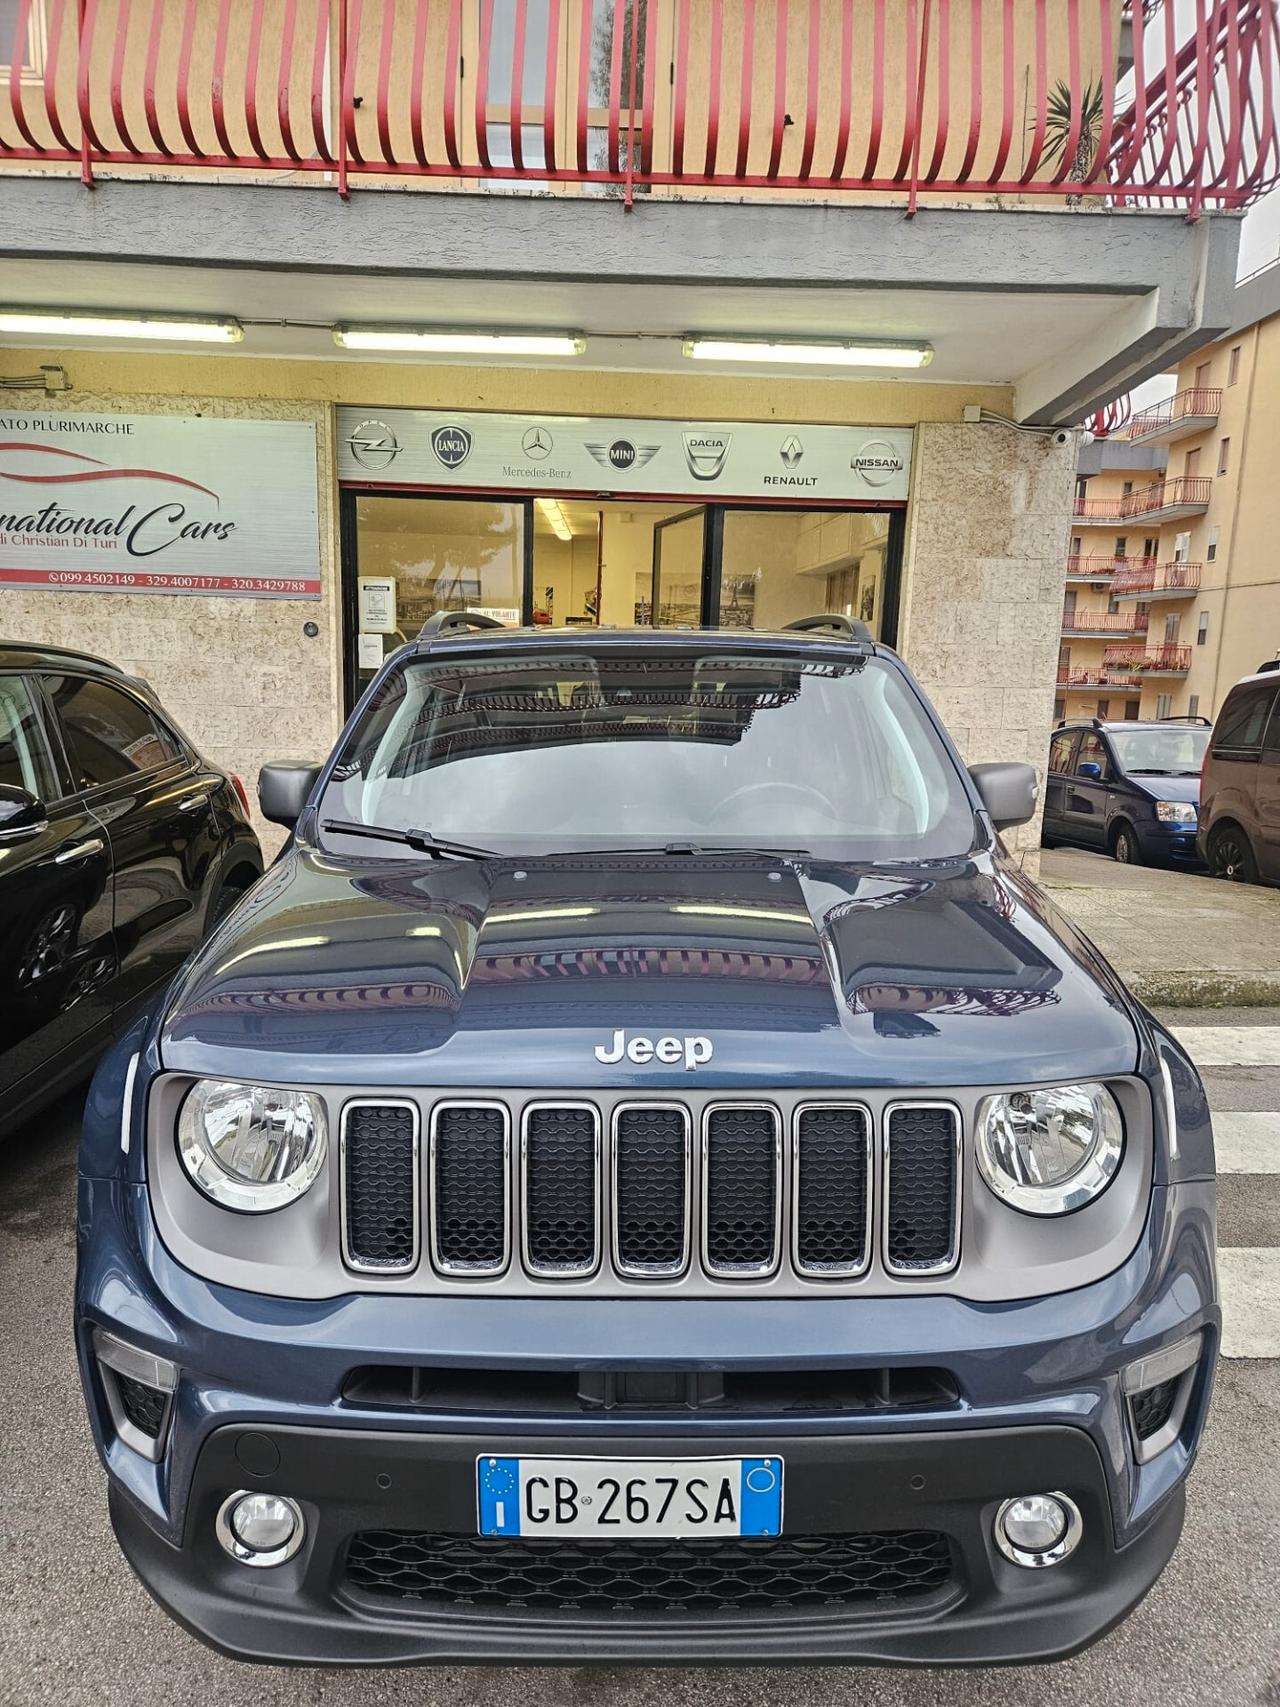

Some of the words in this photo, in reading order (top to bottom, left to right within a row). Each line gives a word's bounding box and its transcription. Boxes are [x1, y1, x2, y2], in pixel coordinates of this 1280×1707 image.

[33, 420, 134, 435] PLURIMARCHE
[438, 440, 465, 452] LANCIA
[689, 438, 723, 448] DACIA
[610, 449, 634, 461] MINI
[855, 457, 898, 468] NISSAN
[502, 466, 571, 479] Mercedes-Benz
[763, 476, 818, 487] RENAULT
[126, 503, 238, 557] Cars
[12, 534, 68, 547] Christian
[73, 537, 87, 548] Di
[92, 538, 117, 549] Turi
[60, 572, 135, 584] 099.4502149
[146, 576, 221, 588] 329.4007177
[231, 579, 306, 592] 320.3429788
[594, 1029, 713, 1071] Jeep
[525, 1477, 579, 1523] GB
[597, 1478, 736, 1524] 267SA
